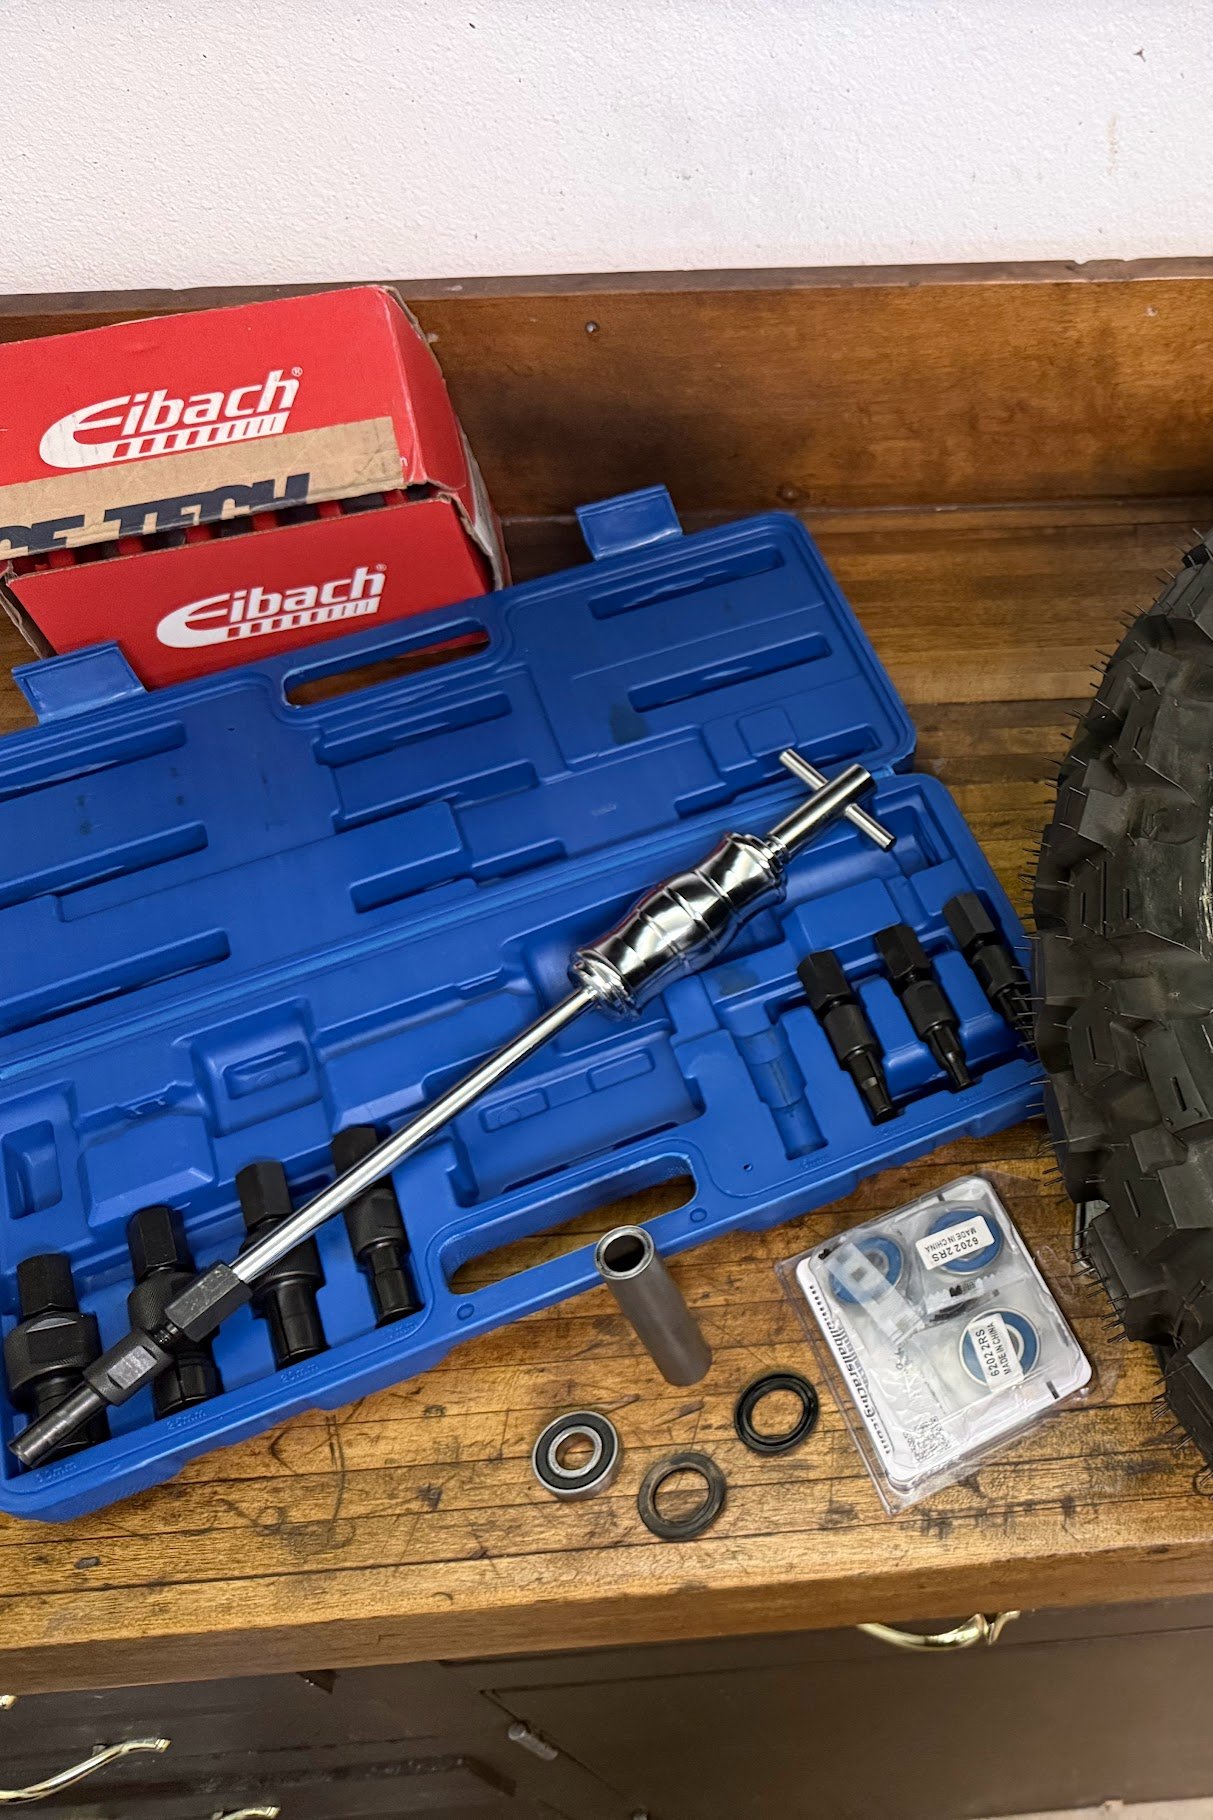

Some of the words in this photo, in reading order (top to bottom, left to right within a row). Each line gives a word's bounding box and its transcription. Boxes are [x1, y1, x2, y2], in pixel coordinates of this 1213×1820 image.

[39, 370, 300, 468] Eibach
[156, 567, 385, 649] Eibach
[947, 1235, 955, 1243] IN
[954, 1226, 978, 1240] MADE
[924, 1239, 947, 1253] CHINA
[930, 1246, 955, 1262] 2RS
[953, 1237, 979, 1252] 6202
[975, 1328, 991, 1351] 2RS
[987, 1321, 1001, 1346] CHINA
[995, 1343, 1005, 1352] IN
[983, 1350, 1001, 1377] 6202
[998, 1350, 1013, 1375] MADE
